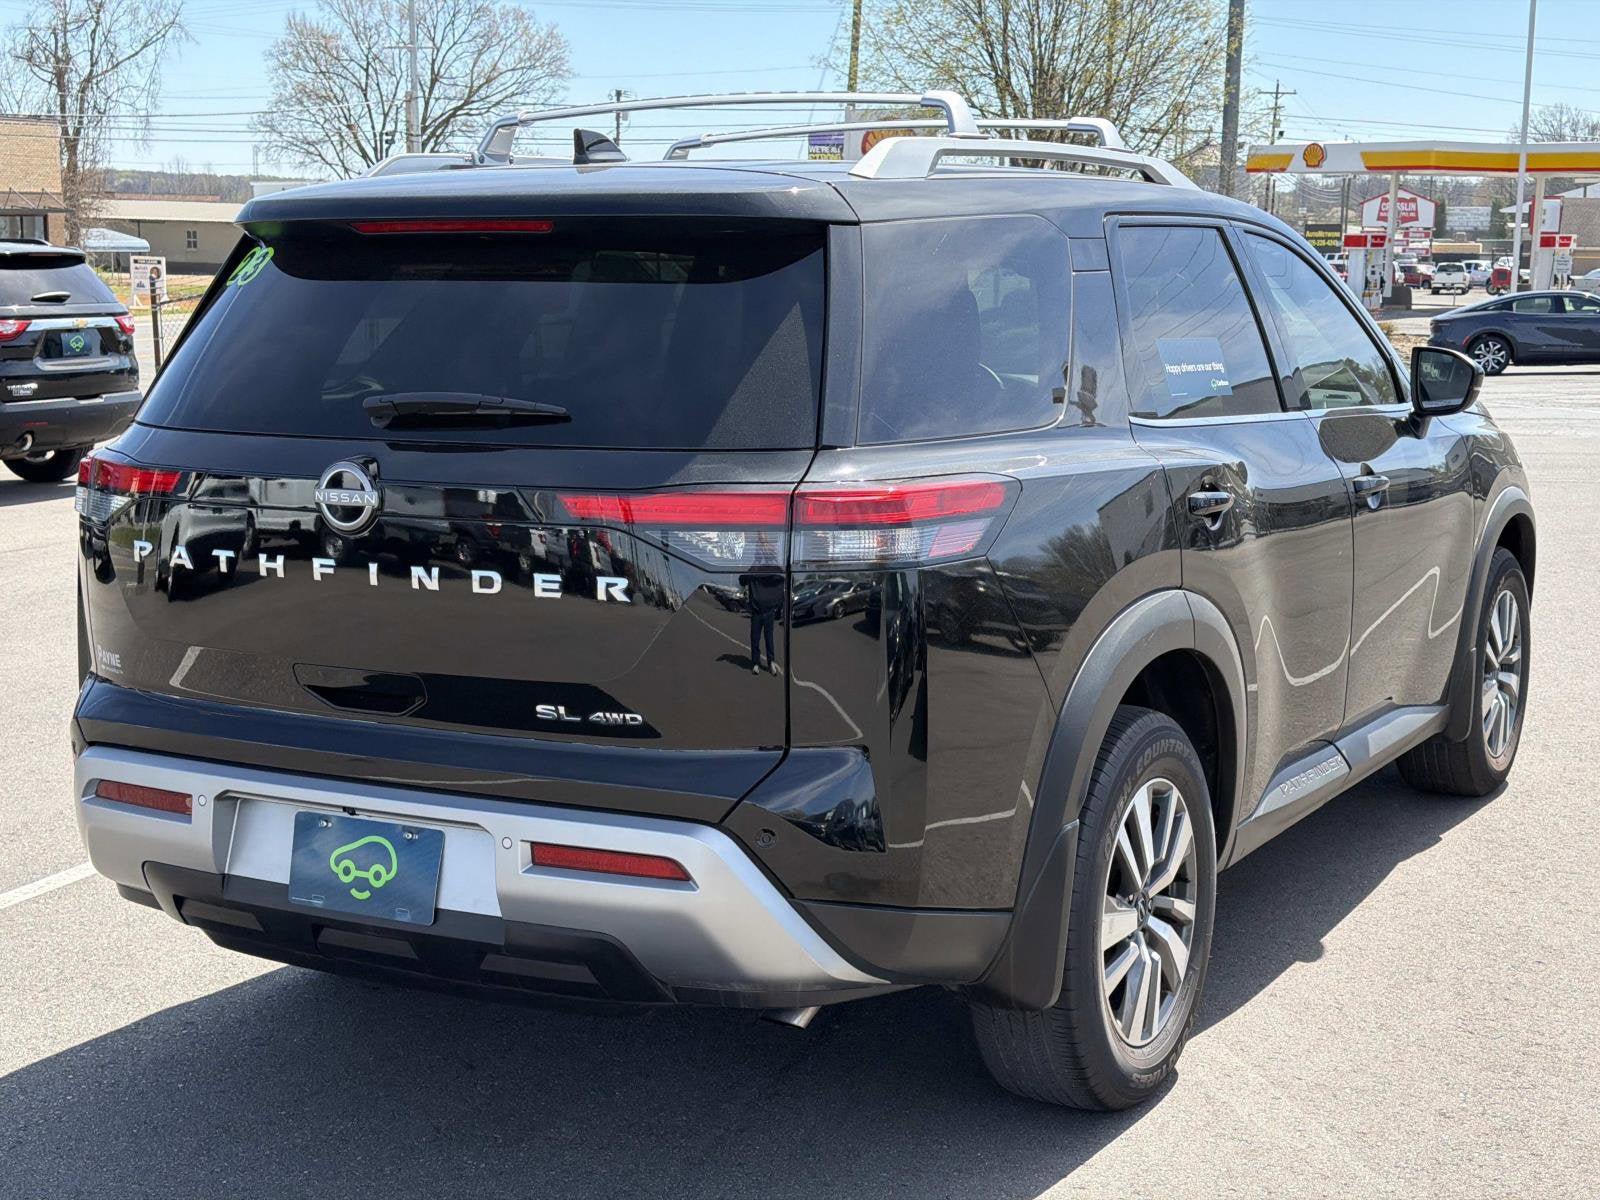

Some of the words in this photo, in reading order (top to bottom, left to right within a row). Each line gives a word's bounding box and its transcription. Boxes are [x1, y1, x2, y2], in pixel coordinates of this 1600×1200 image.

[315, 491, 376, 505] NISSAN
[133, 539, 631, 604] PATHFINDER
[535, 704, 581, 721] SL
[588, 711, 643, 726] 4WD
[1280, 755, 1345, 798] PATHFINDER
